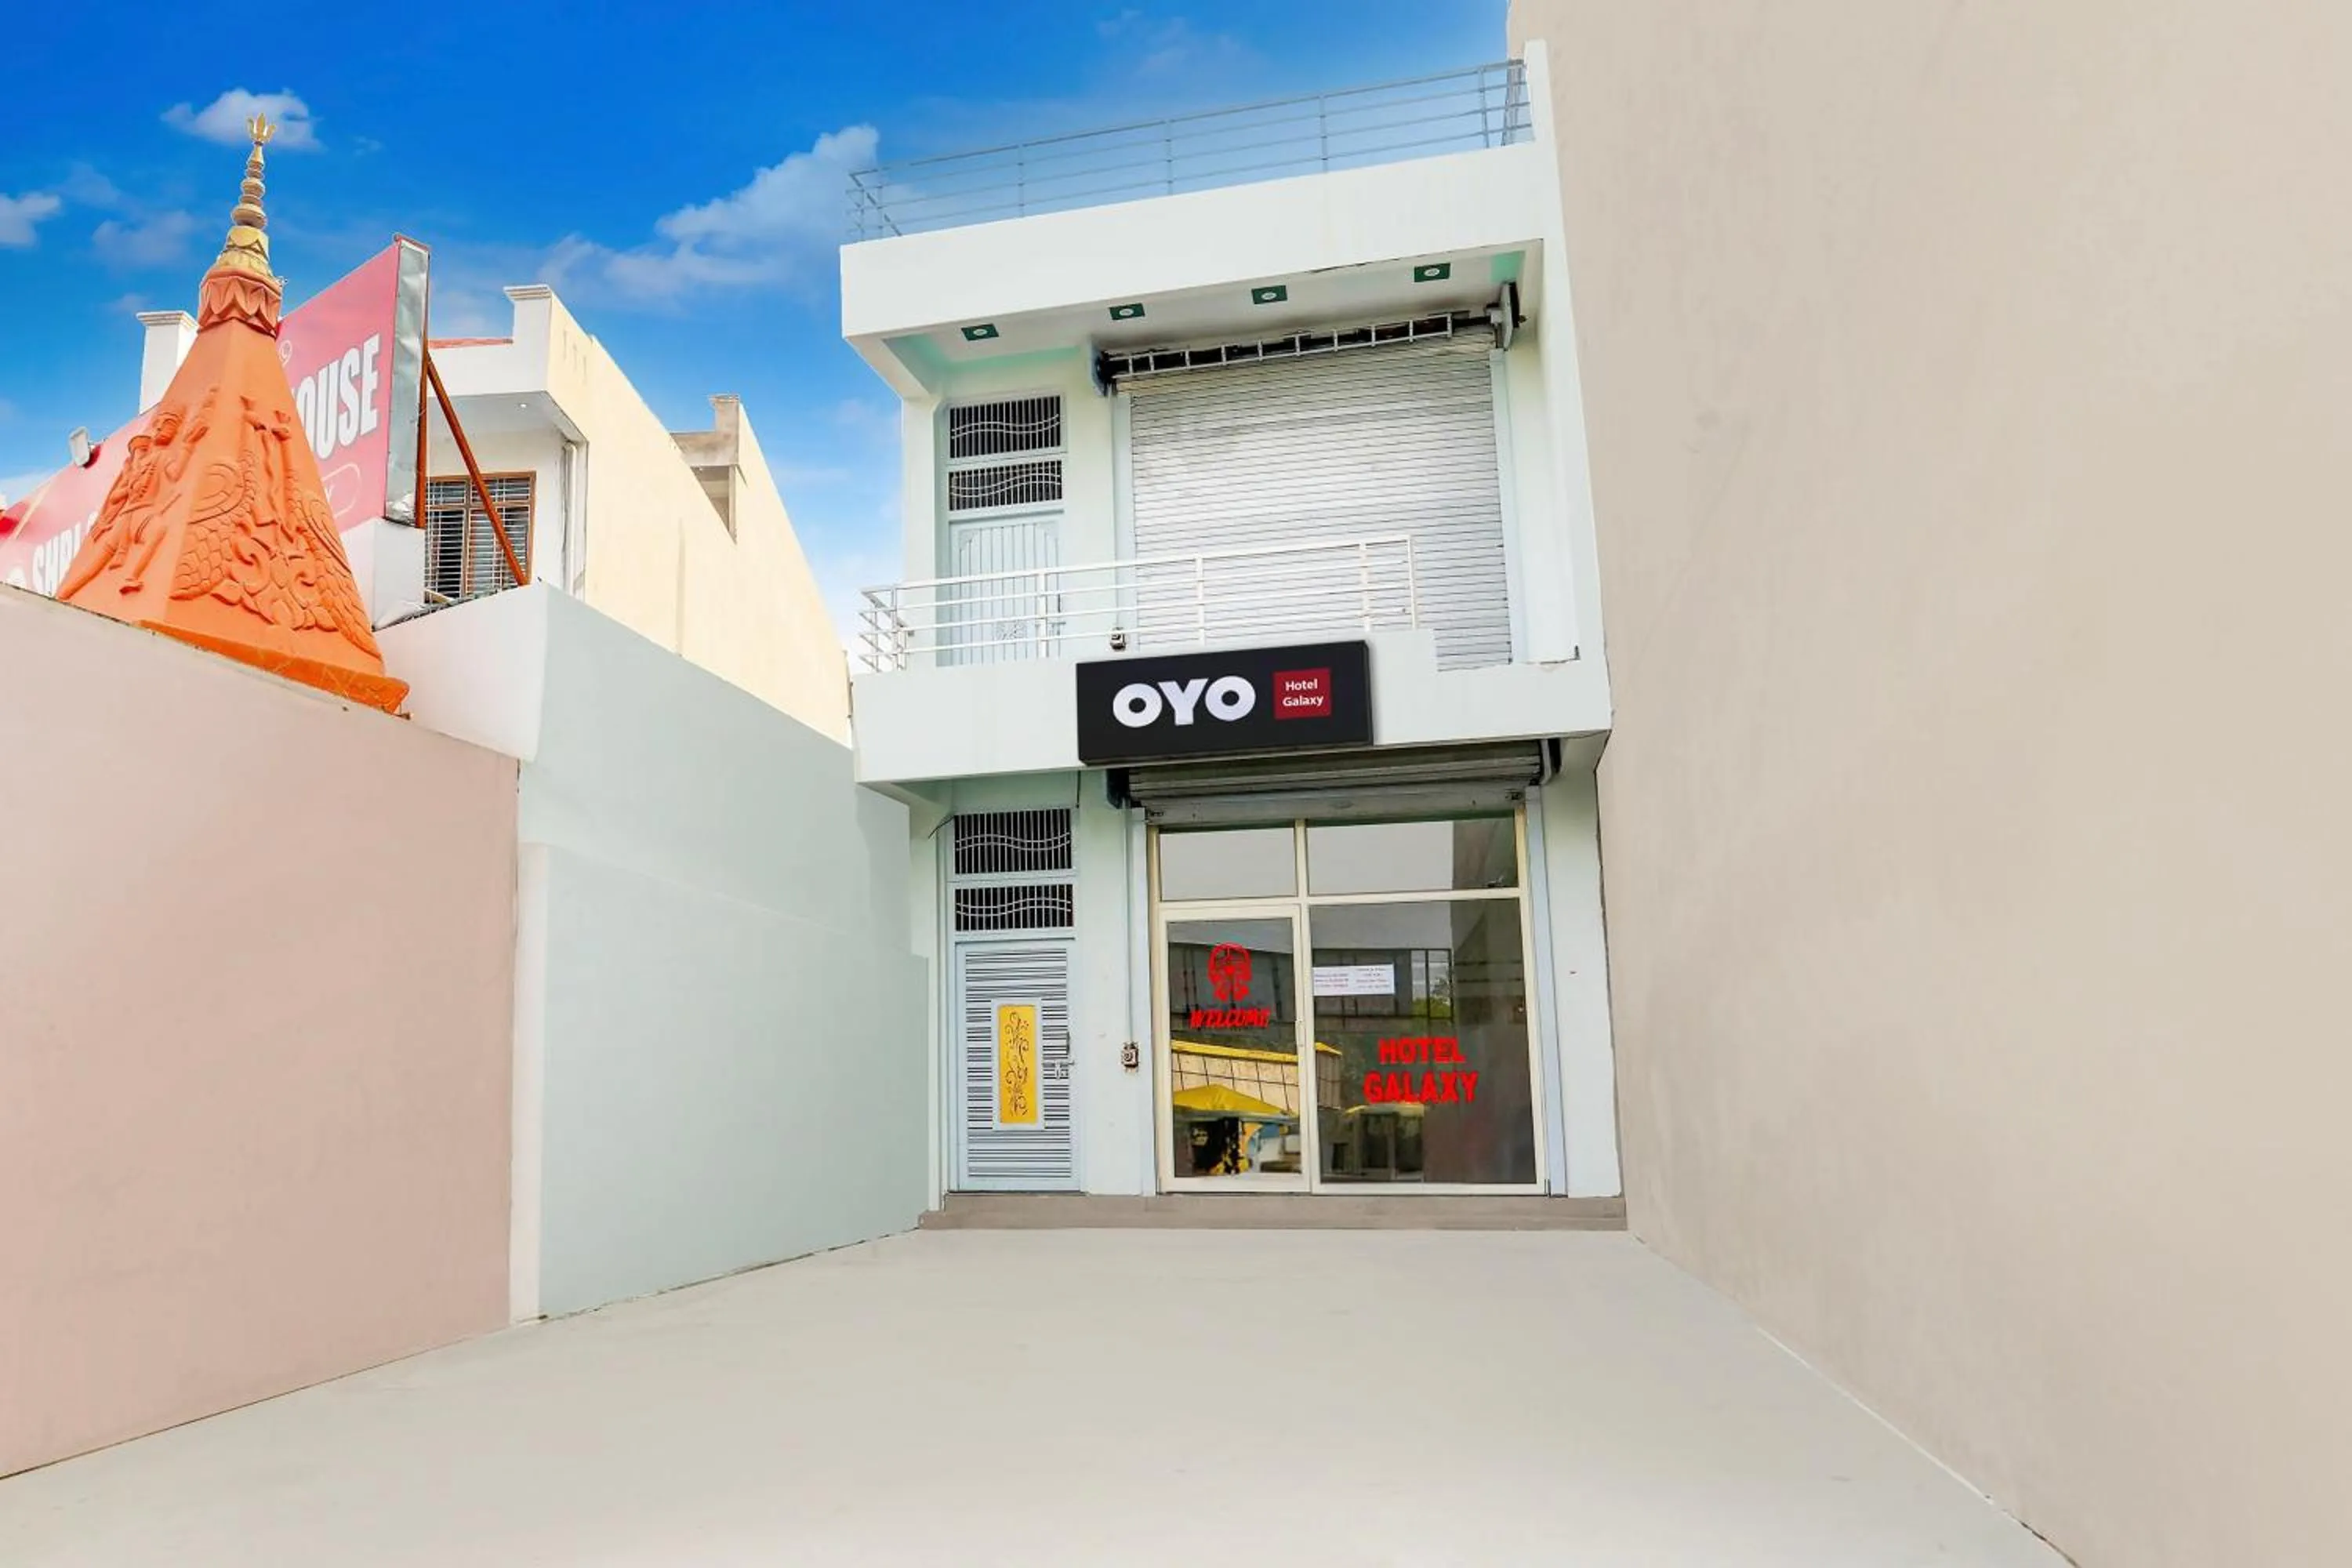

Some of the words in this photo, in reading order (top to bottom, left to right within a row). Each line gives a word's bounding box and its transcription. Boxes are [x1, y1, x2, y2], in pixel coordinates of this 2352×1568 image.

[291, 334, 379, 458] OUSE
[1285, 678, 1318, 691] Hotel
[1112, 675, 1256, 728] OYO
[1282, 695, 1324, 707] Galaxy
[1378, 1036, 1466, 1064] HOTEL
[1364, 1070, 1479, 1103] GALAXY
